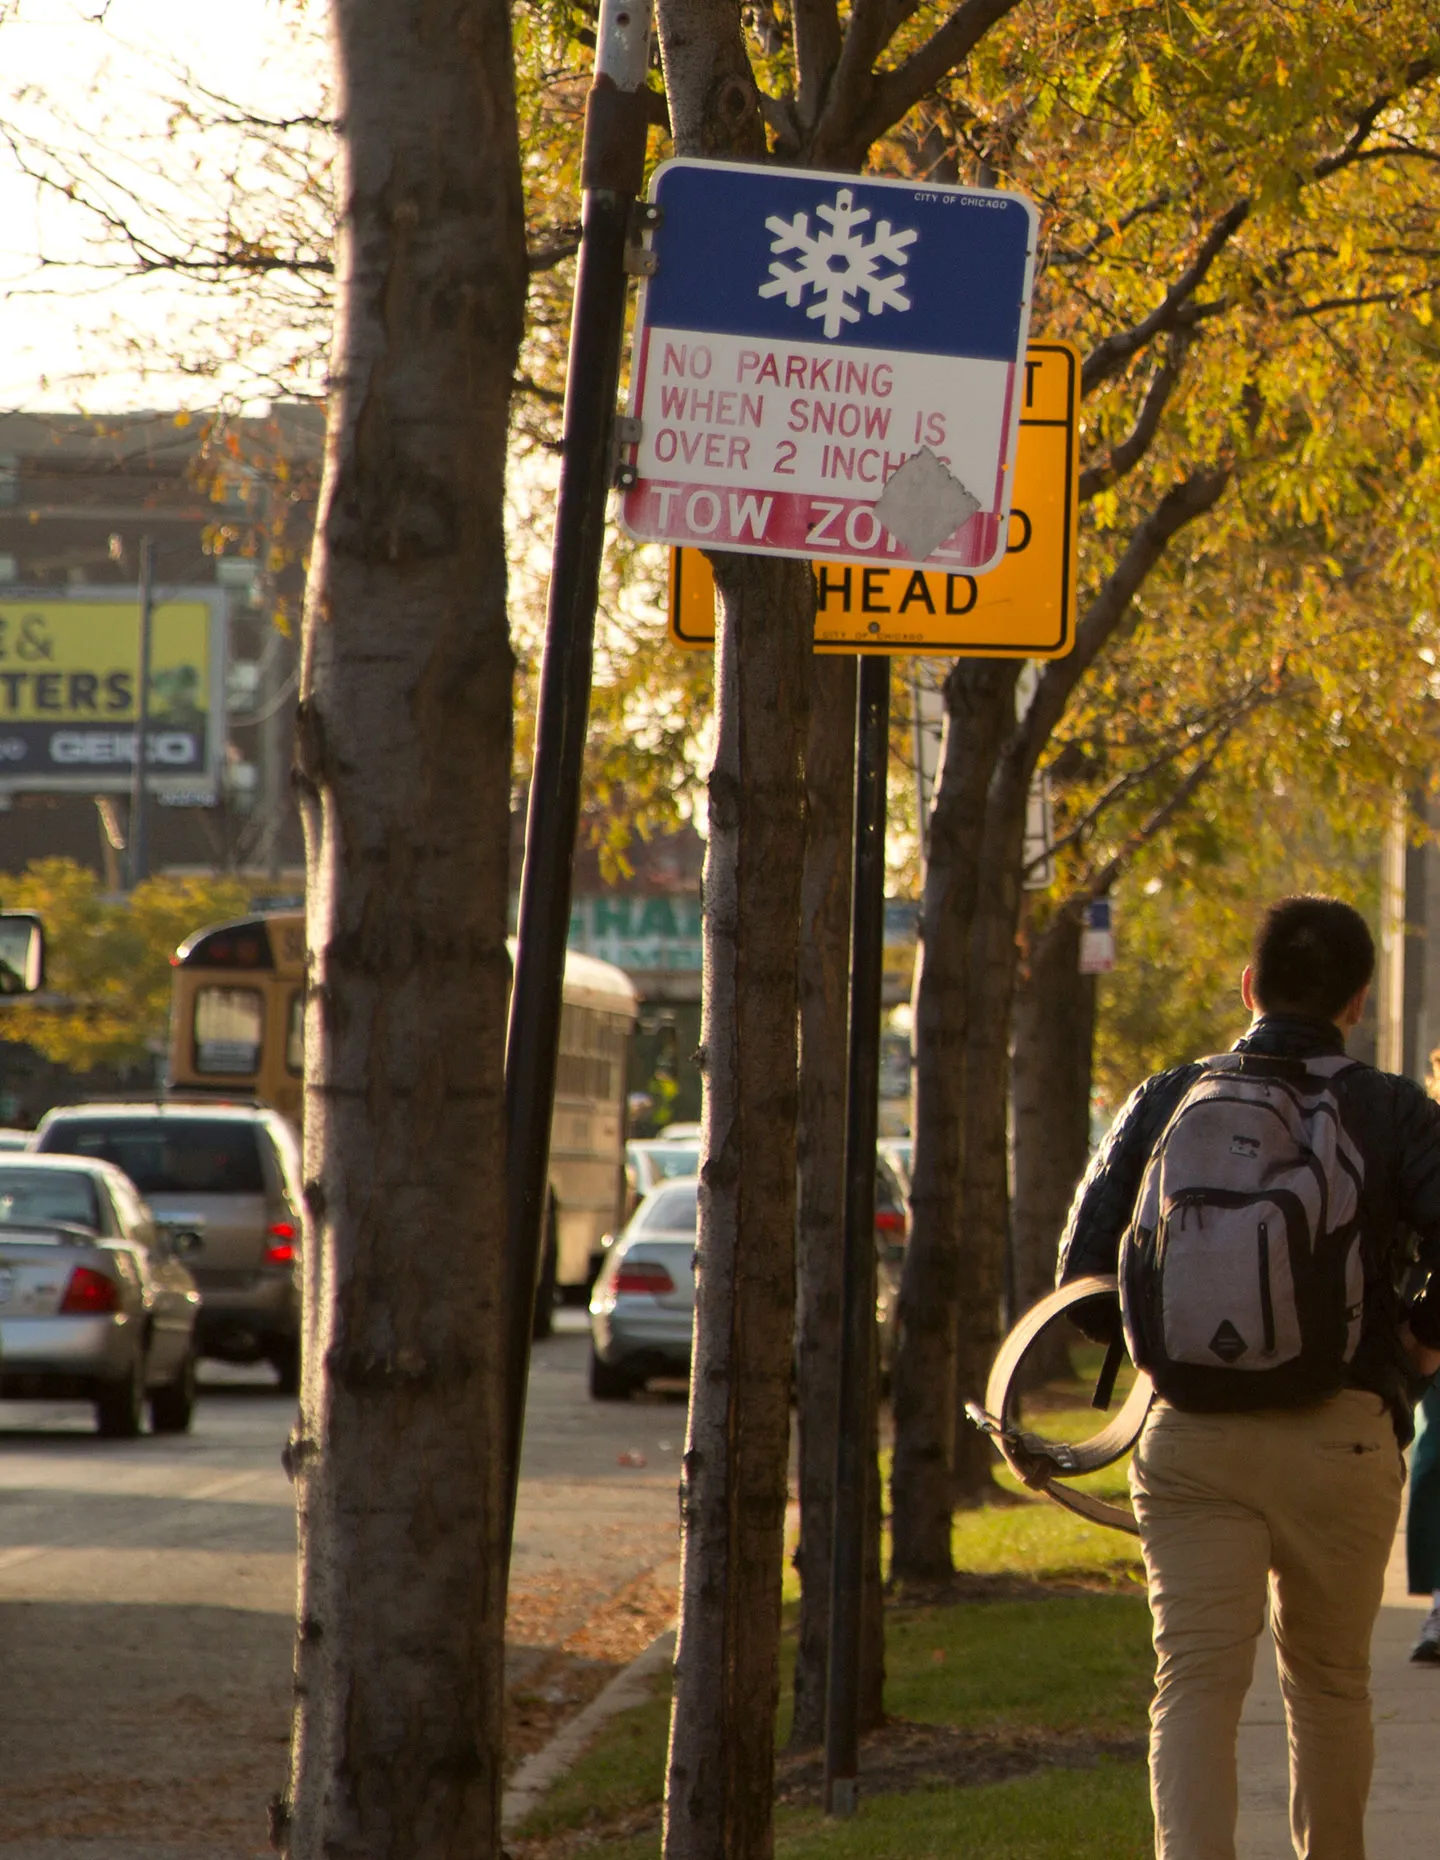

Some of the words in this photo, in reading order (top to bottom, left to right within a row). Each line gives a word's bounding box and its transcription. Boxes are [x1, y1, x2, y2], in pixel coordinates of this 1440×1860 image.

[914, 192, 938, 204] CITY
[943, 195, 956, 205] OF
[960, 197, 1008, 210] CHICAGO
[662, 342, 712, 379] NO
[736, 350, 894, 398] PARKING
[660, 385, 764, 428] WHEN
[787, 398, 892, 441] SNOW
[914, 410, 946, 446] IS
[654, 428, 751, 470] OVER
[773, 440, 798, 475] 2
[820, 444, 951, 485] INCH
[650, 485, 774, 540] TOW
[819, 566, 978, 615] HEAD
